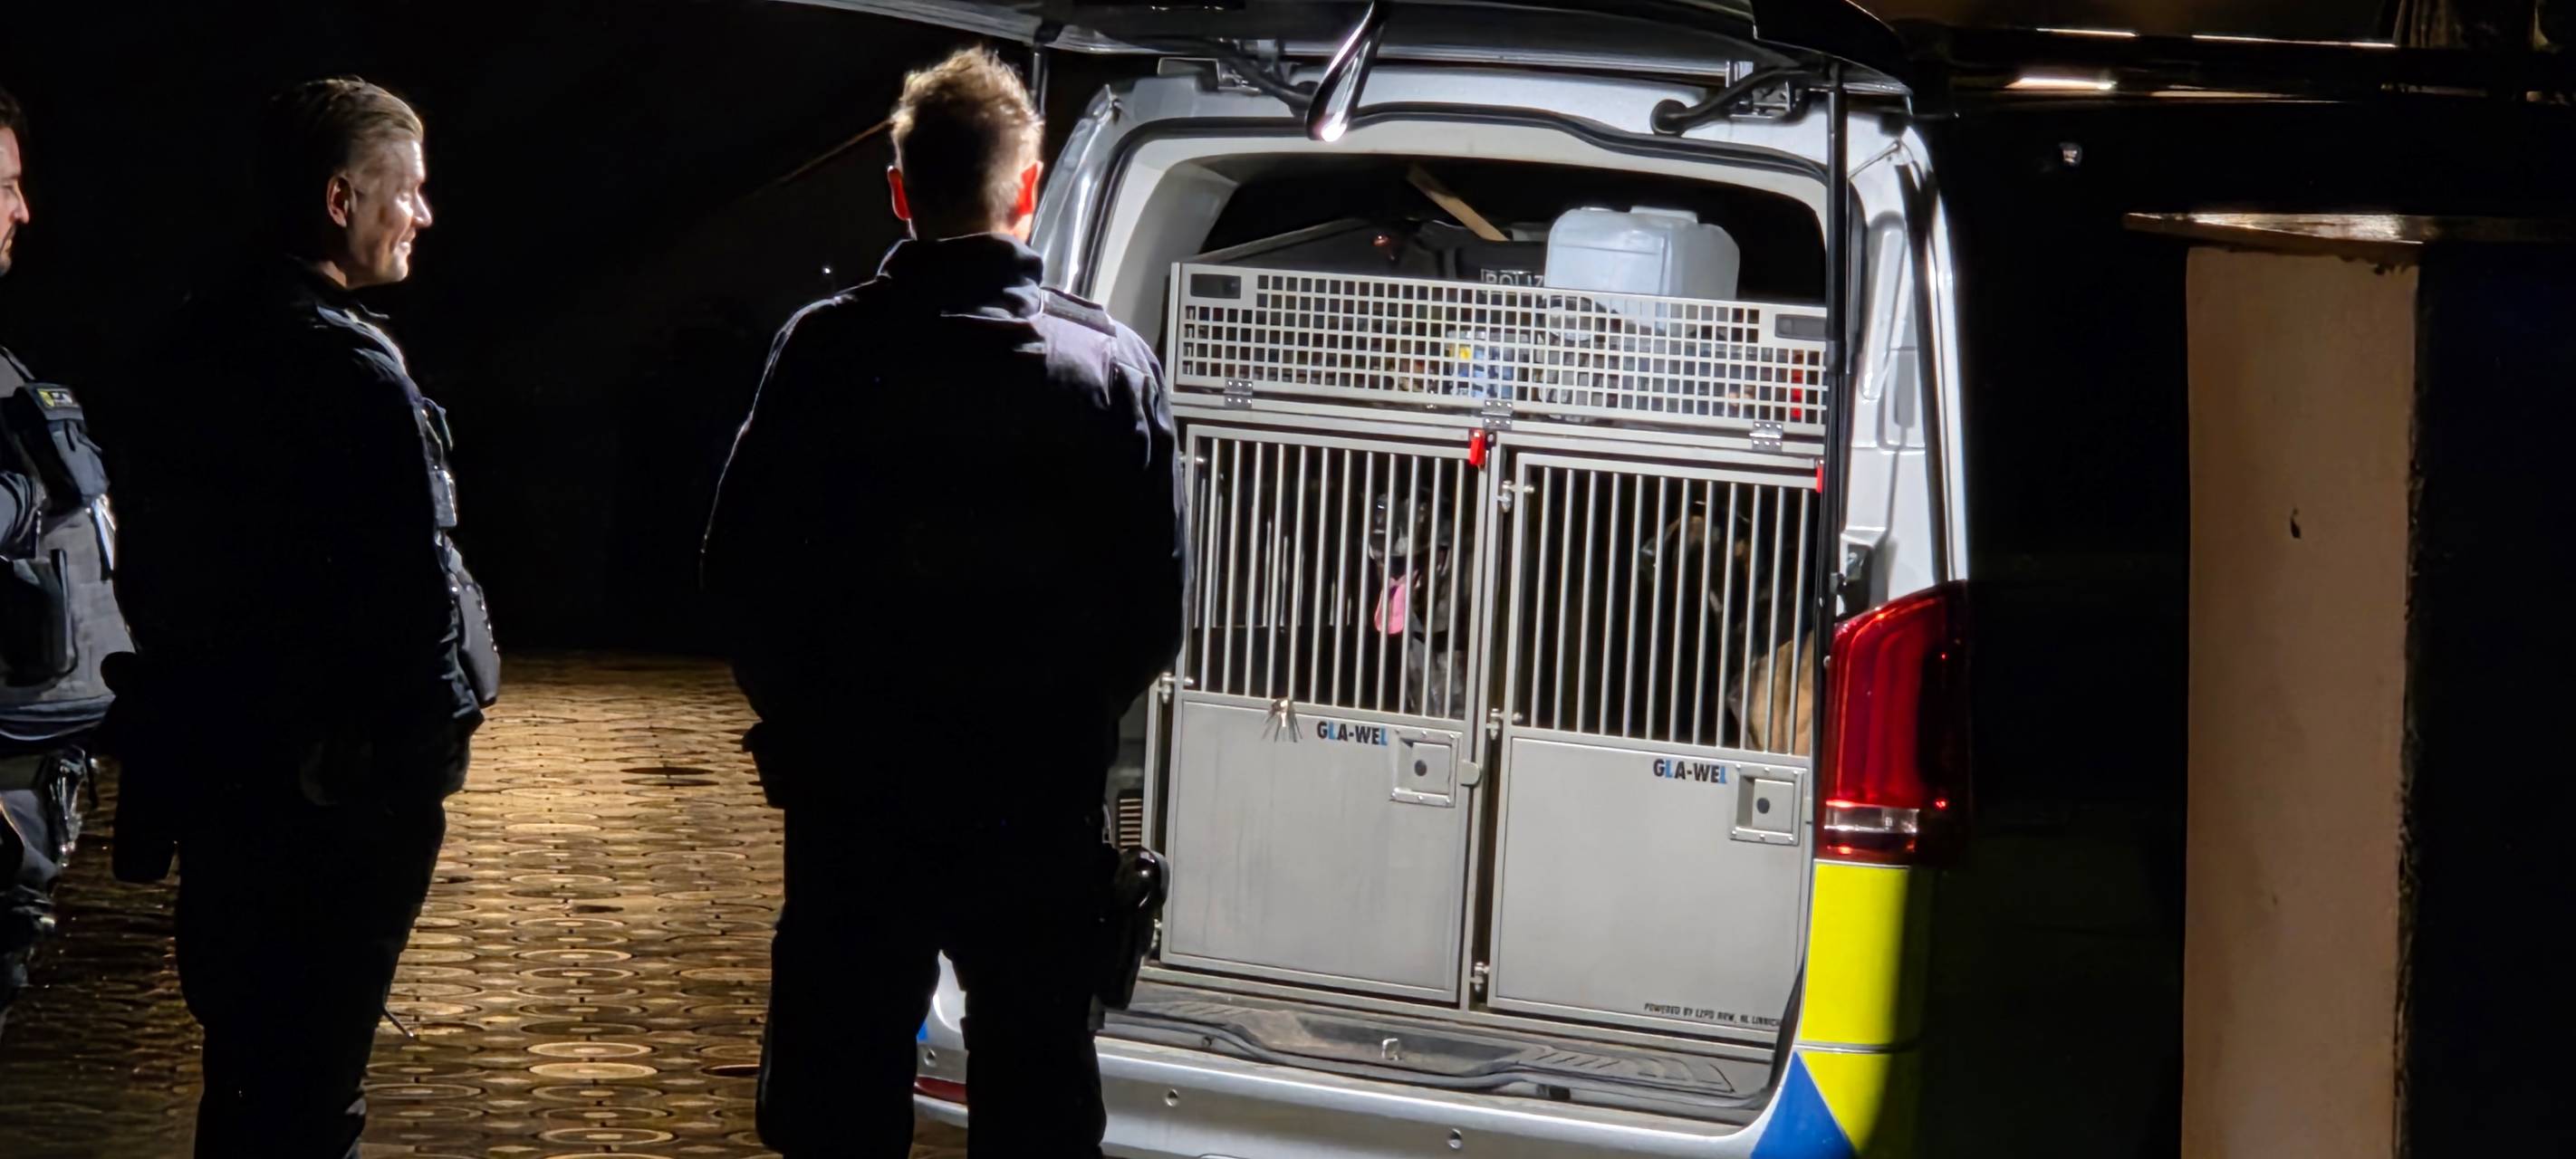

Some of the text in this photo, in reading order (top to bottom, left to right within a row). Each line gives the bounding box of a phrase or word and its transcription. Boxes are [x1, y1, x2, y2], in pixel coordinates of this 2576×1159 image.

[1485, 273, 1545, 288] POLIZ
[1317, 721, 1388, 746] GLA-WEL
[1653, 759, 1727, 784] GLA-WEL
